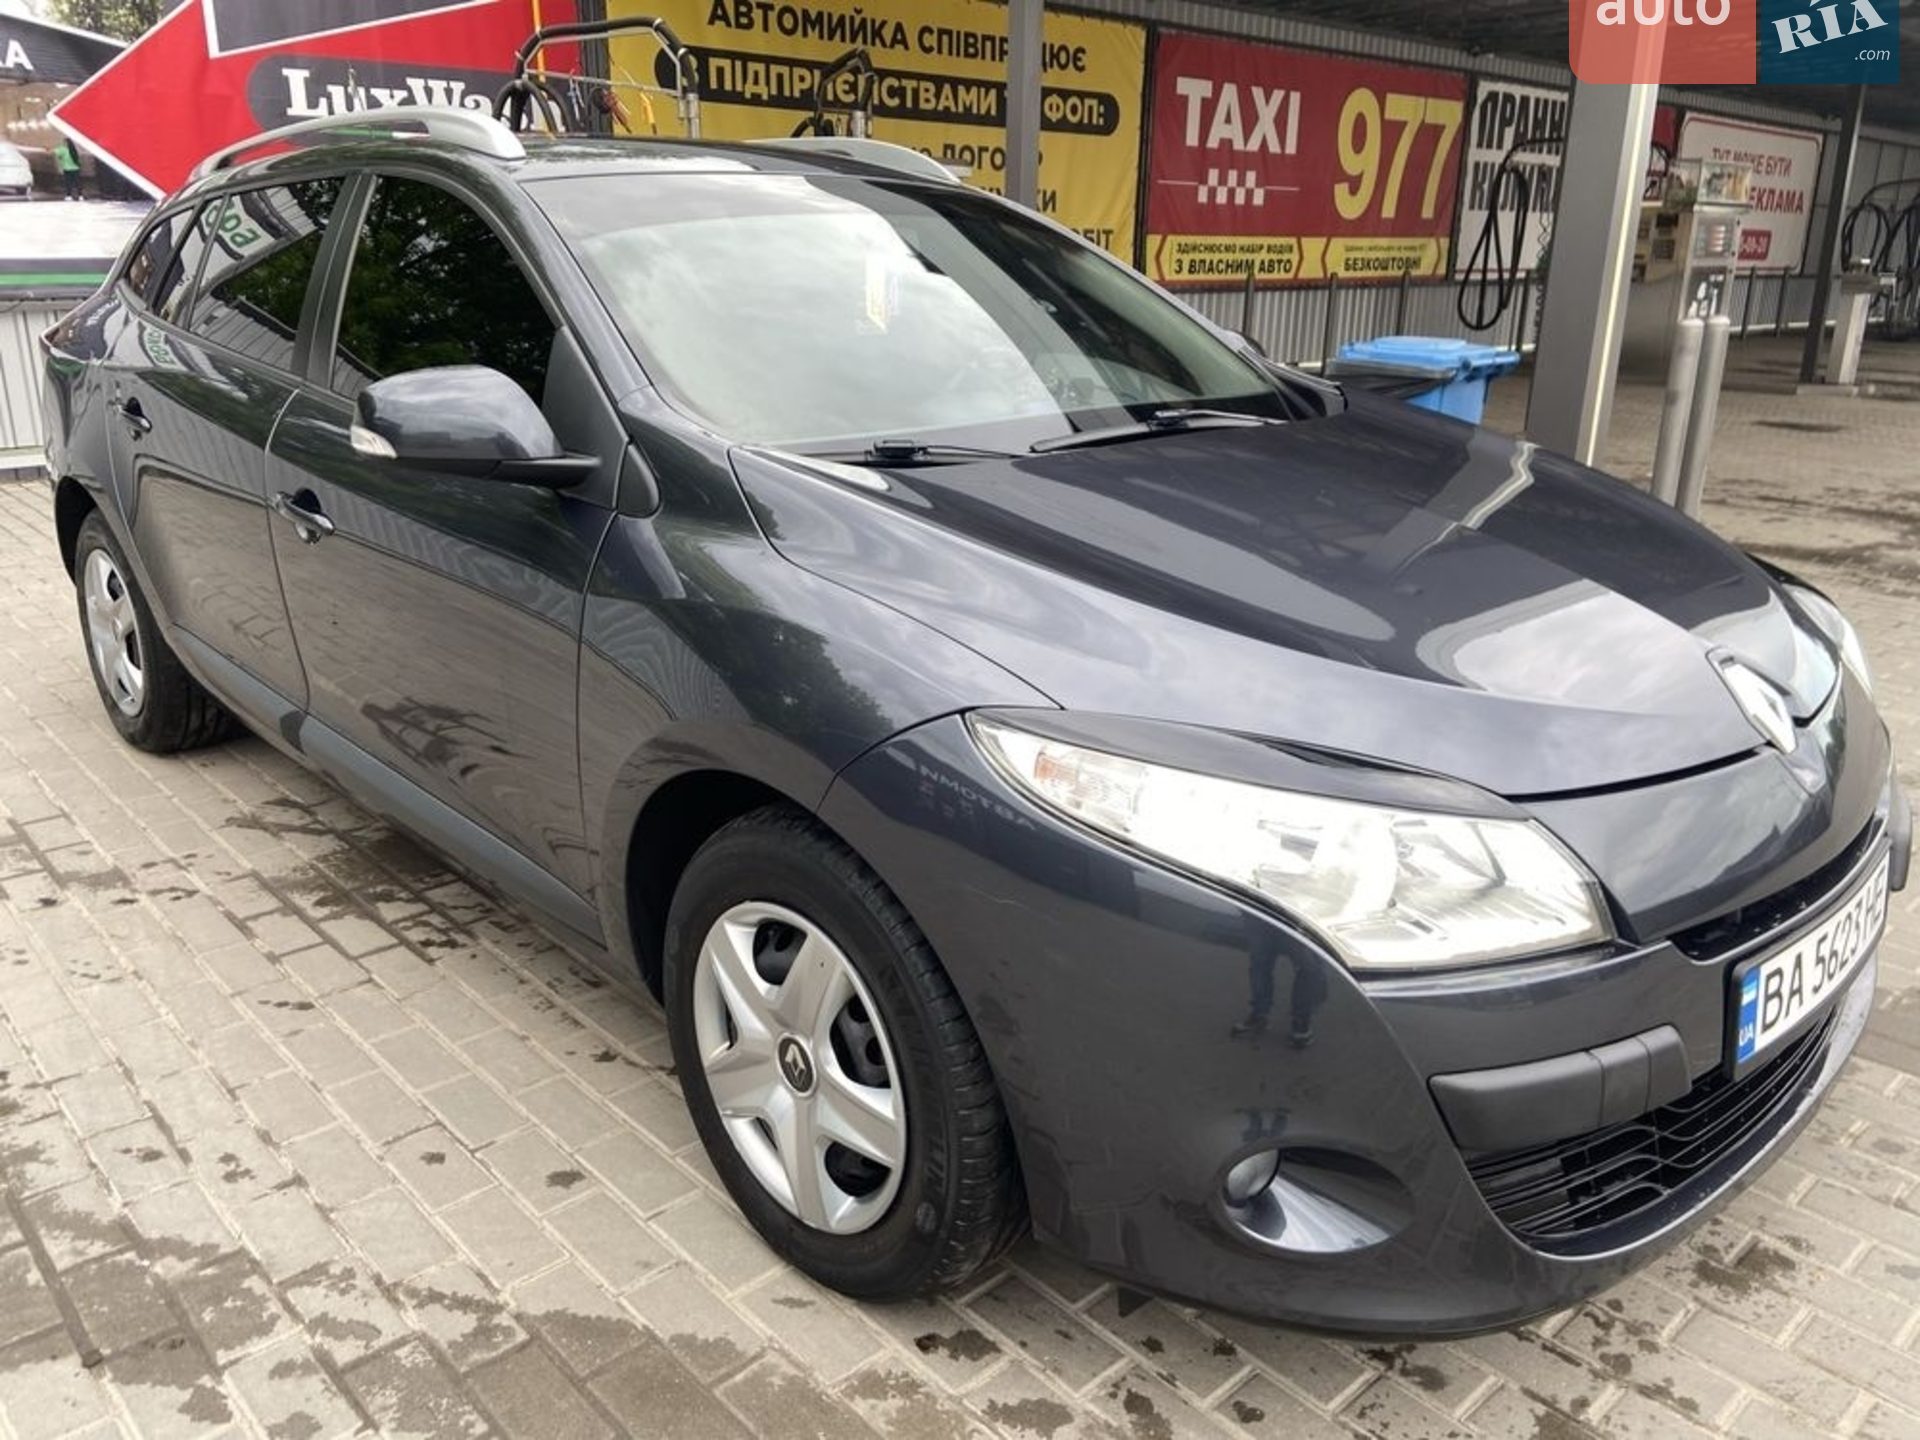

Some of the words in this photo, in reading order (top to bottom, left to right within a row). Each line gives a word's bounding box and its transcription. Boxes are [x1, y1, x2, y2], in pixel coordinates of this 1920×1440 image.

[707, 0, 909, 51] АВТОМИЙКА
[917, 25, 1087, 73] СПІВПРЮЄ
[281, 67, 567, 132] LuxWa
[1043, 94, 1105, 126] ФОП:
[1176, 76, 1301, 155] TAXI
[1334, 87, 1464, 220] 977
[1712, 147, 1731, 162] ТУТ
[1766, 154, 1792, 177] БУТИ
[1750, 186, 1804, 214] ЕКЛАМА
[1174, 258, 1183, 274] З
[1187, 258, 1255, 275] ВЛАСНИМ
[1258, 258, 1294, 274] АВТО
[1761, 952, 1804, 1035] BA
[1812, 897, 1862, 995] 5623
[1738, 1022, 1755, 1047] UA
